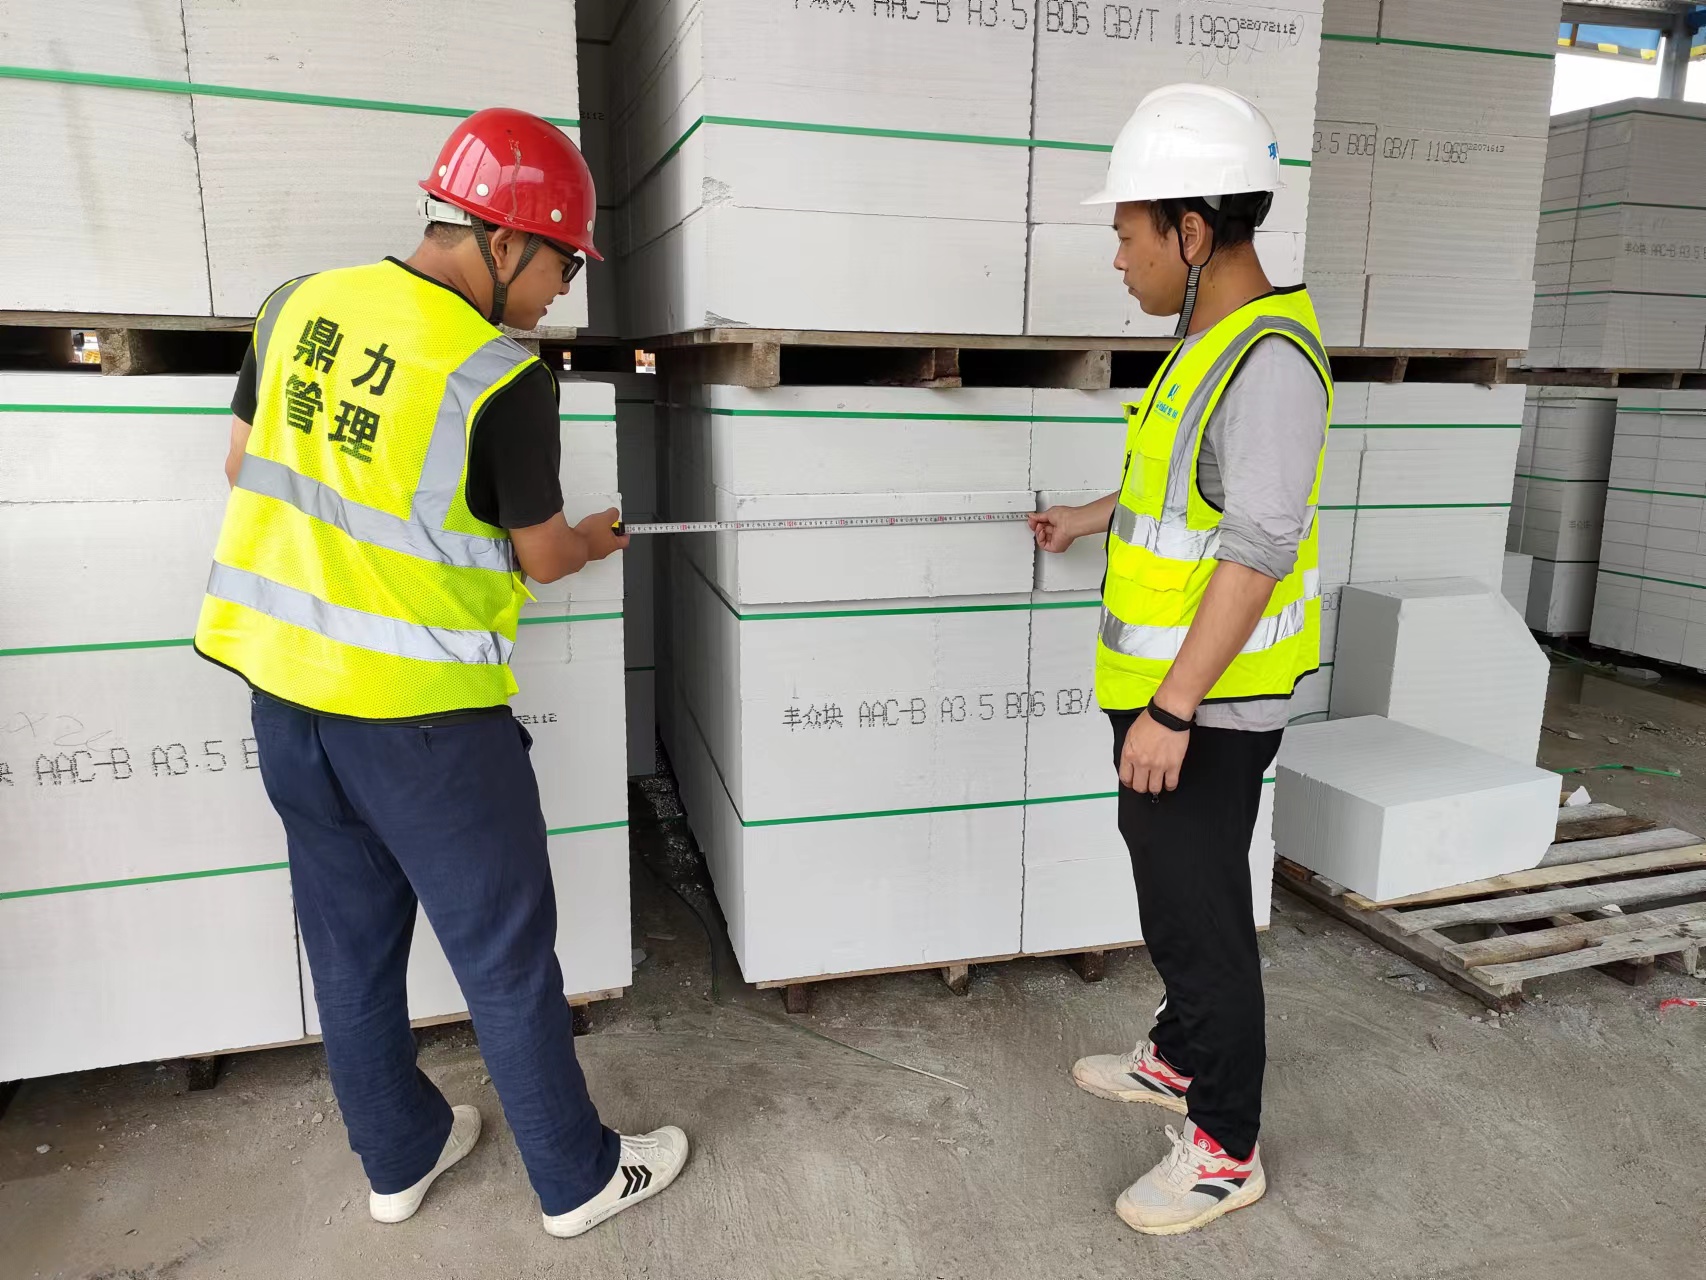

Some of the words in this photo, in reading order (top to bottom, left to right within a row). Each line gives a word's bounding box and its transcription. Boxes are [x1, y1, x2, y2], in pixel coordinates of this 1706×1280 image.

[1103, 4, 1160, 42] GB/T
[1175, 13, 1240, 50] 11968
[1383, 136, 1419, 160] GB/T
[293, 316, 397, 396] 鼎力
[285, 373, 380, 464] 管理
[859, 697, 927, 728] AAC-B
[36, 747, 133, 786] AAC-B
[152, 740, 227, 778] A3.5
